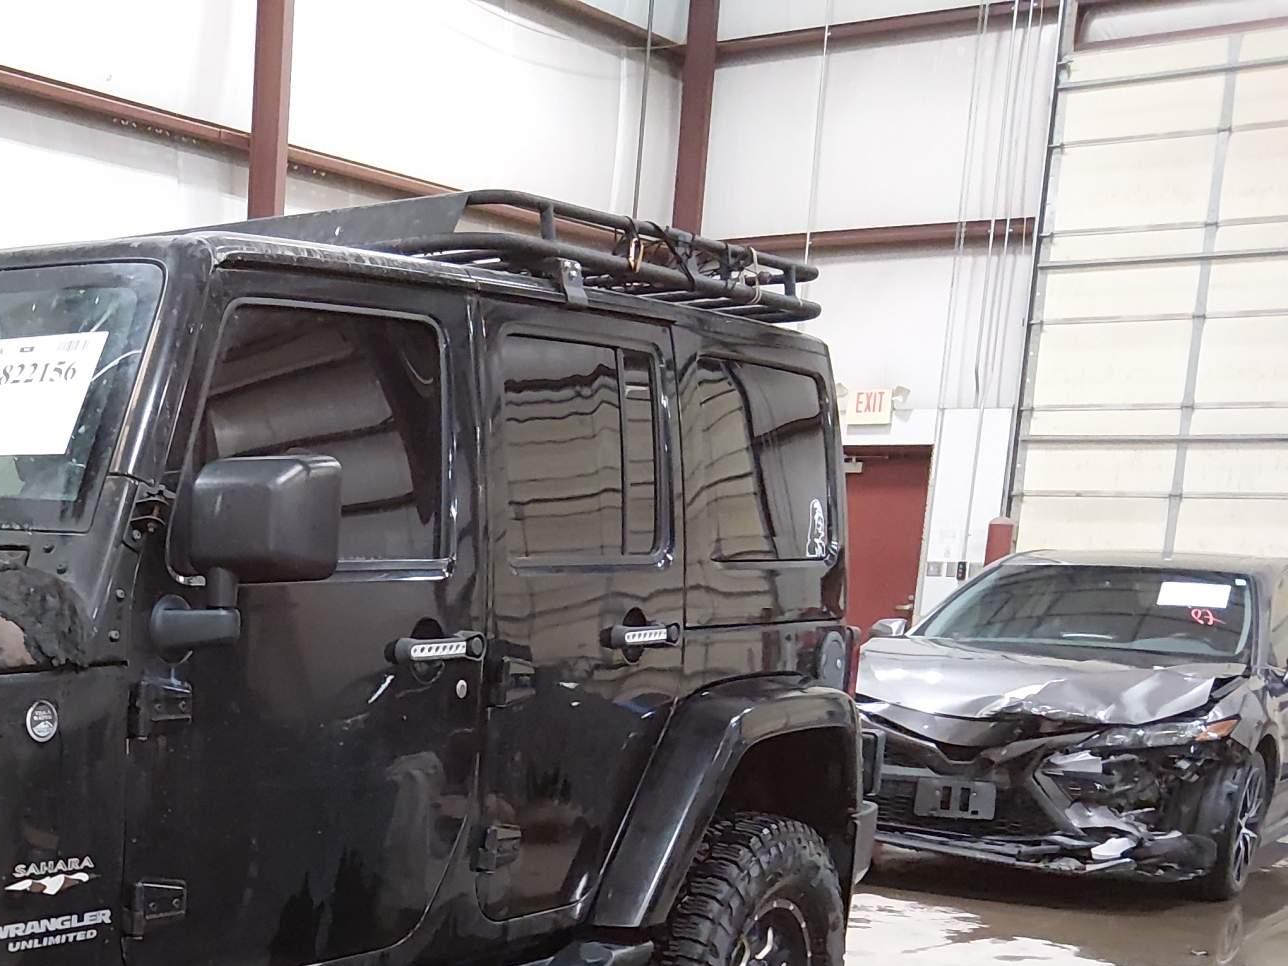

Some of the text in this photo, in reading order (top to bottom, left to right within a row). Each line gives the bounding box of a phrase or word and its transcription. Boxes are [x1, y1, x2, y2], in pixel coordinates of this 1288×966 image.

[855, 391, 885, 413] EXIT
[13, 856, 94, 877] SAHARA
[8, 929, 97, 952] UNLIMITED
